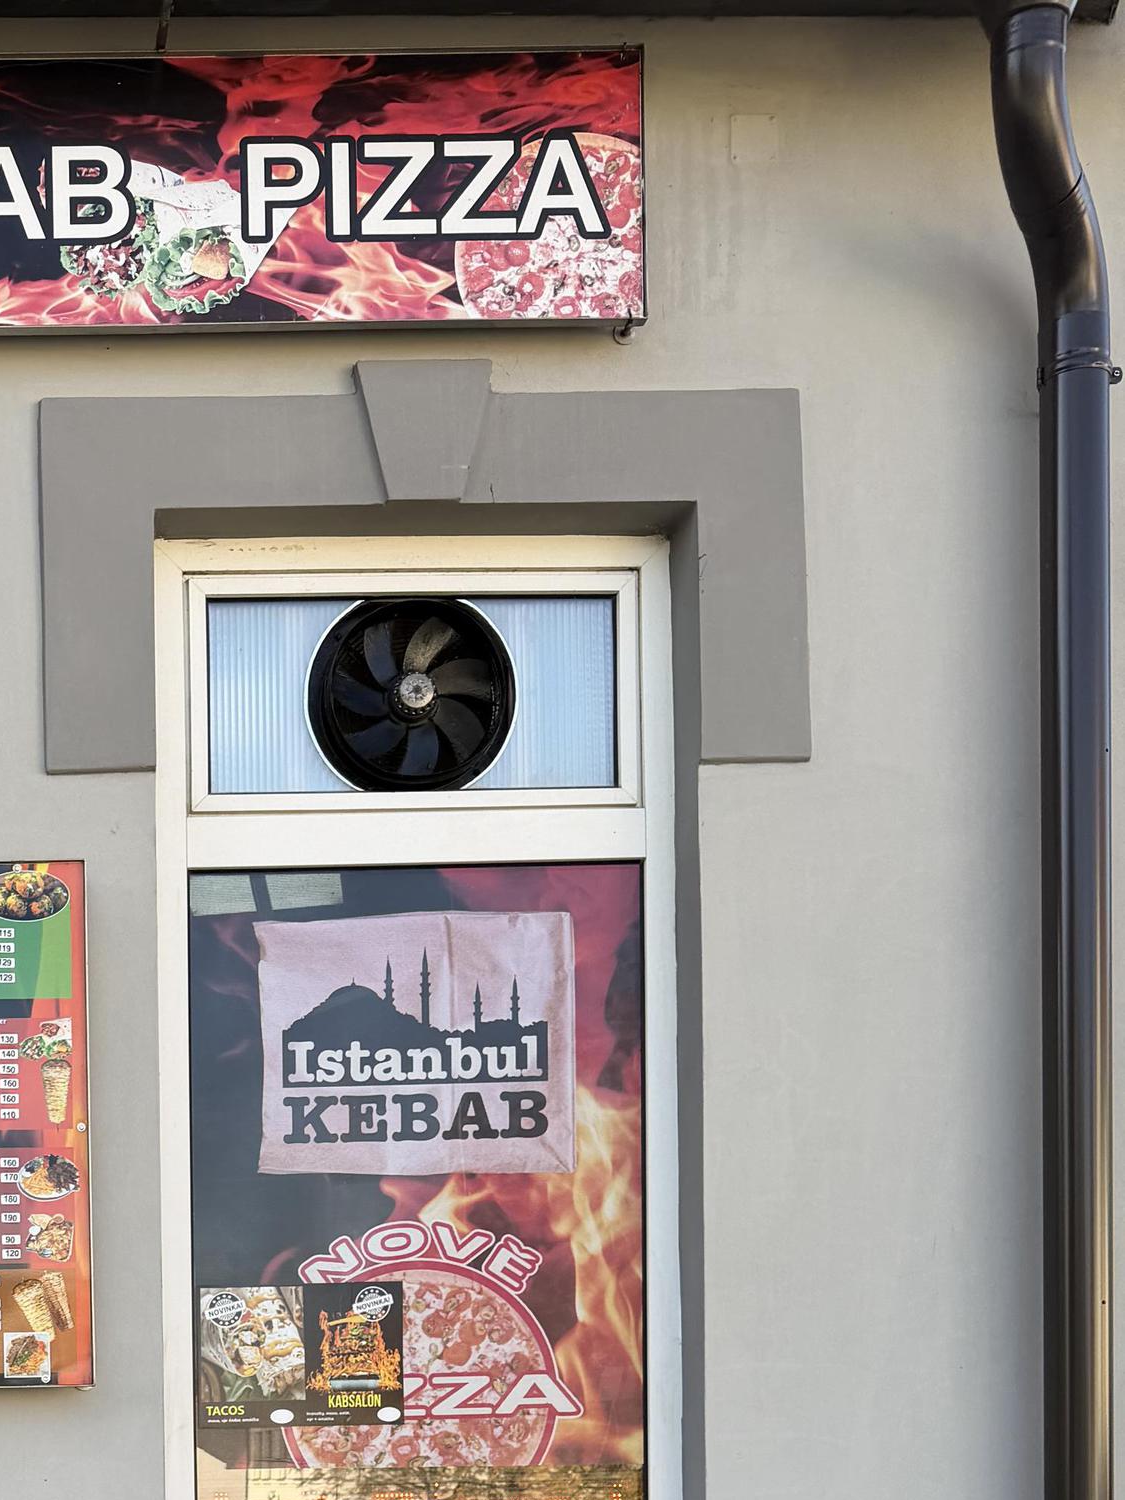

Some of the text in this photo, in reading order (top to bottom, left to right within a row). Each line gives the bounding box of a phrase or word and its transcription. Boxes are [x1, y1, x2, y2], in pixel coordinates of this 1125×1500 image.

[246, 138, 605, 237] PIZZA
[0, 929, 12, 937] 115
[287, 1035, 543, 1083] Istanbul
[283, 1090, 549, 1144] KEBAB
[208, 1302, 244, 1318] NOVINKA!
[355, 1296, 391, 1311] NOVINKA!
[205, 1405, 245, 1416] TACOS
